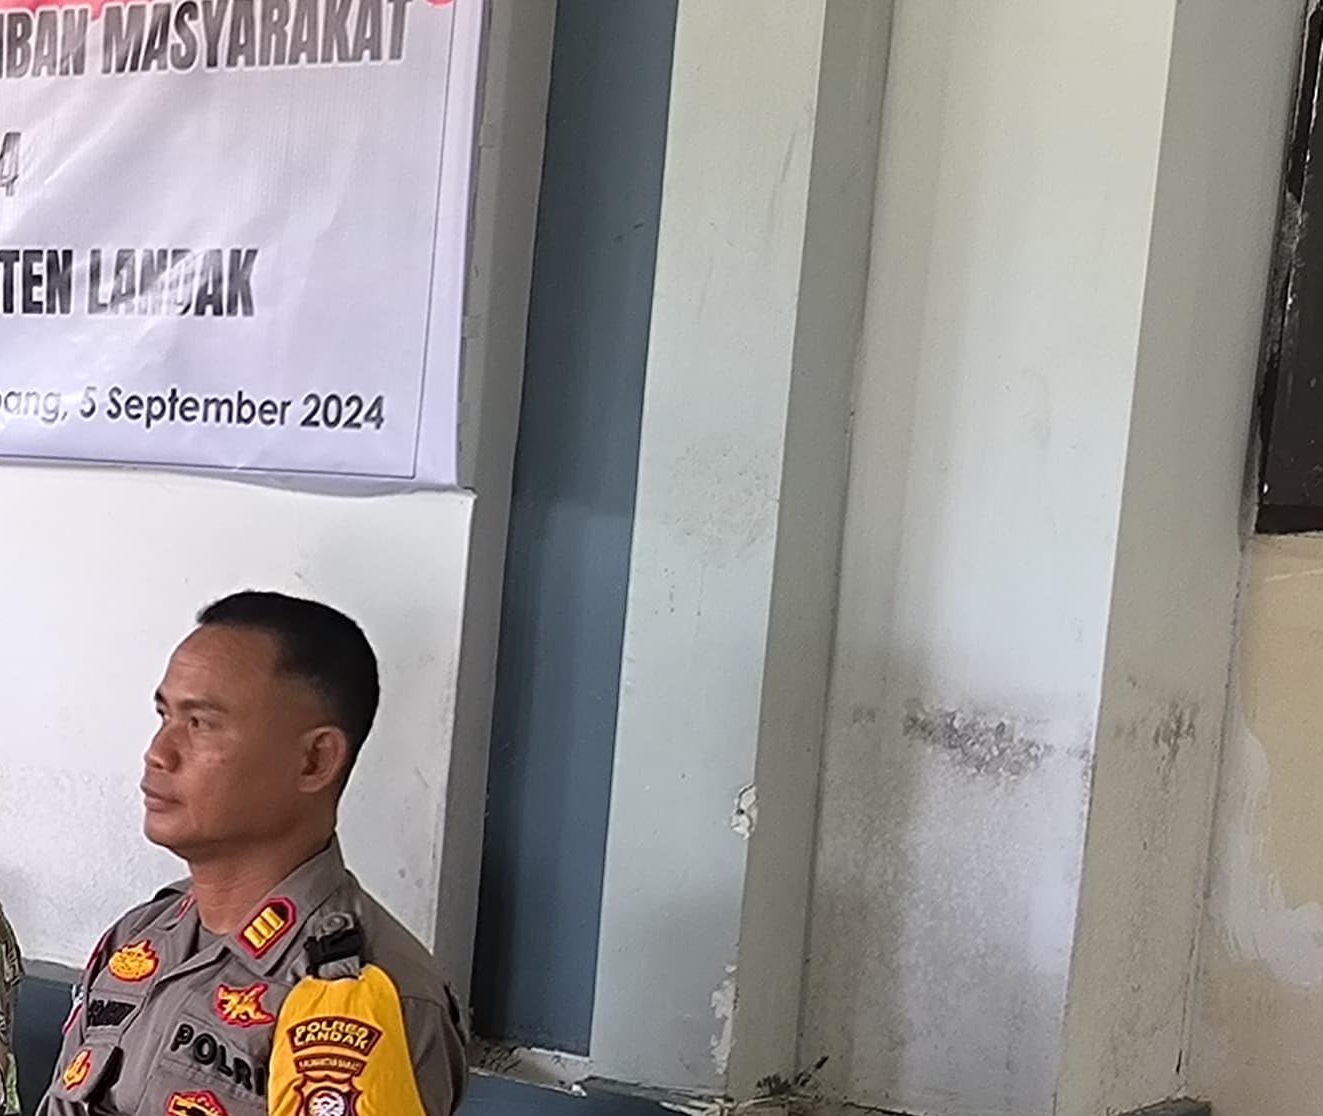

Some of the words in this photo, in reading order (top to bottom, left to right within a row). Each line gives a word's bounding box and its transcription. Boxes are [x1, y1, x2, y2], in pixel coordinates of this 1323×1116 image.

[101, 0, 412, 74] MASYARAKAT
[87, 249, 258, 316] LANDAK
[80, 386, 97, 418] 5
[106, 386, 291, 428] September
[300, 393, 385, 430] 2024
[171, 1024, 266, 1096] POLRI
[294, 1031, 369, 1050] LANDAK
